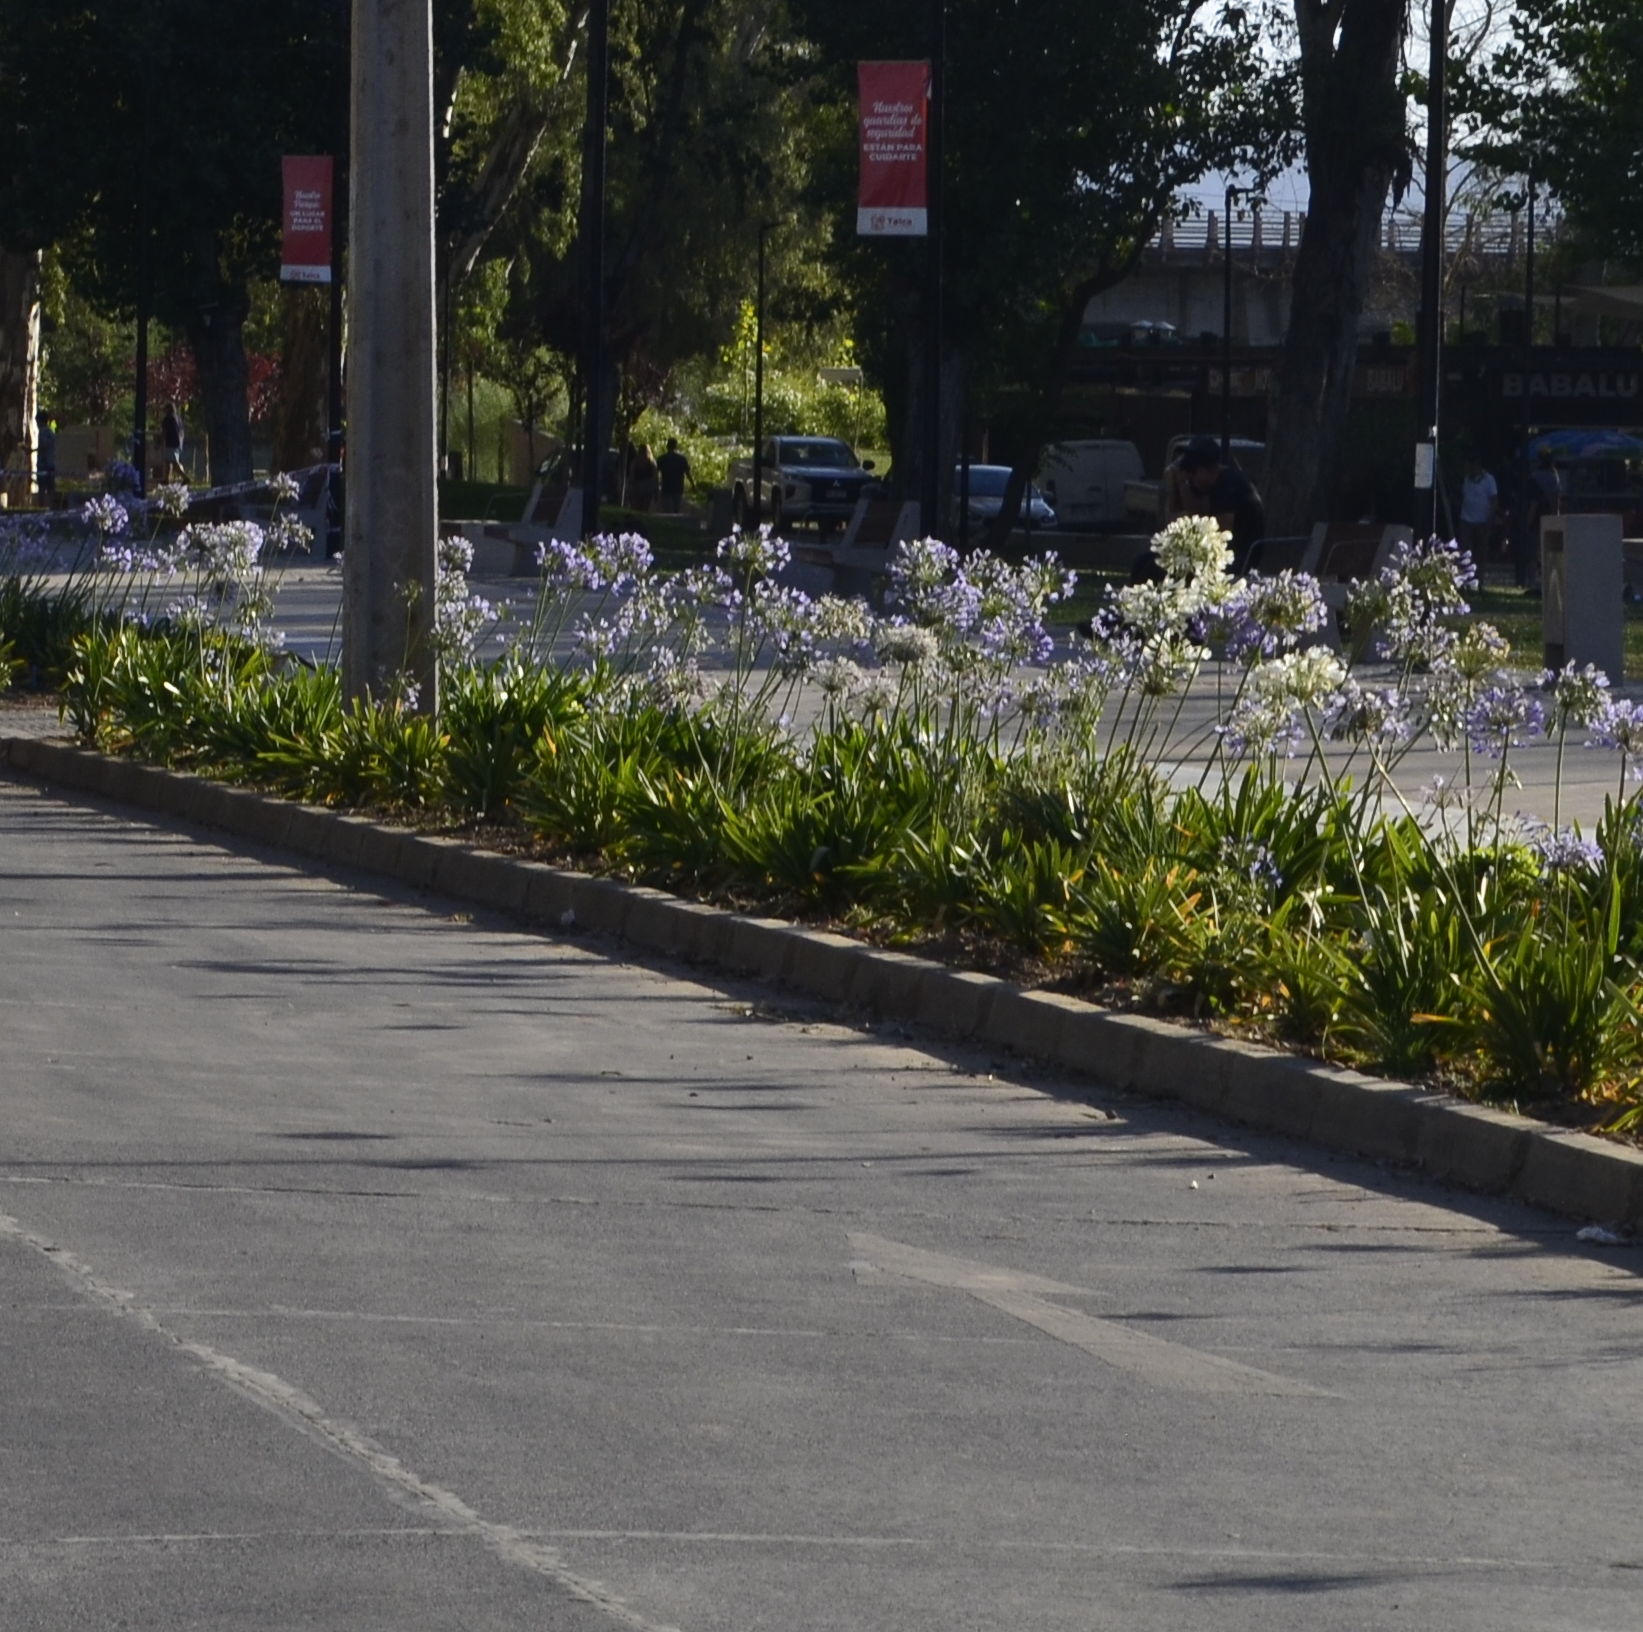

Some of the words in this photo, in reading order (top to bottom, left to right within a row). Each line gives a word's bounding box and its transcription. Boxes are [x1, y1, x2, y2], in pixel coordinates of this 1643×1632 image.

[872, 101, 913, 114] Nuestros
[863, 112, 908, 128] guardias
[910, 113, 922, 126] de
[866, 124, 915, 142] seguridad
[863, 141, 894, 152] ESTÁN
[897, 143, 922, 152] PARA
[869, 153, 917, 161] CUIDARTE
[887, 217, 912, 227] Talca
[1502, 372, 1639, 398] BABALU
